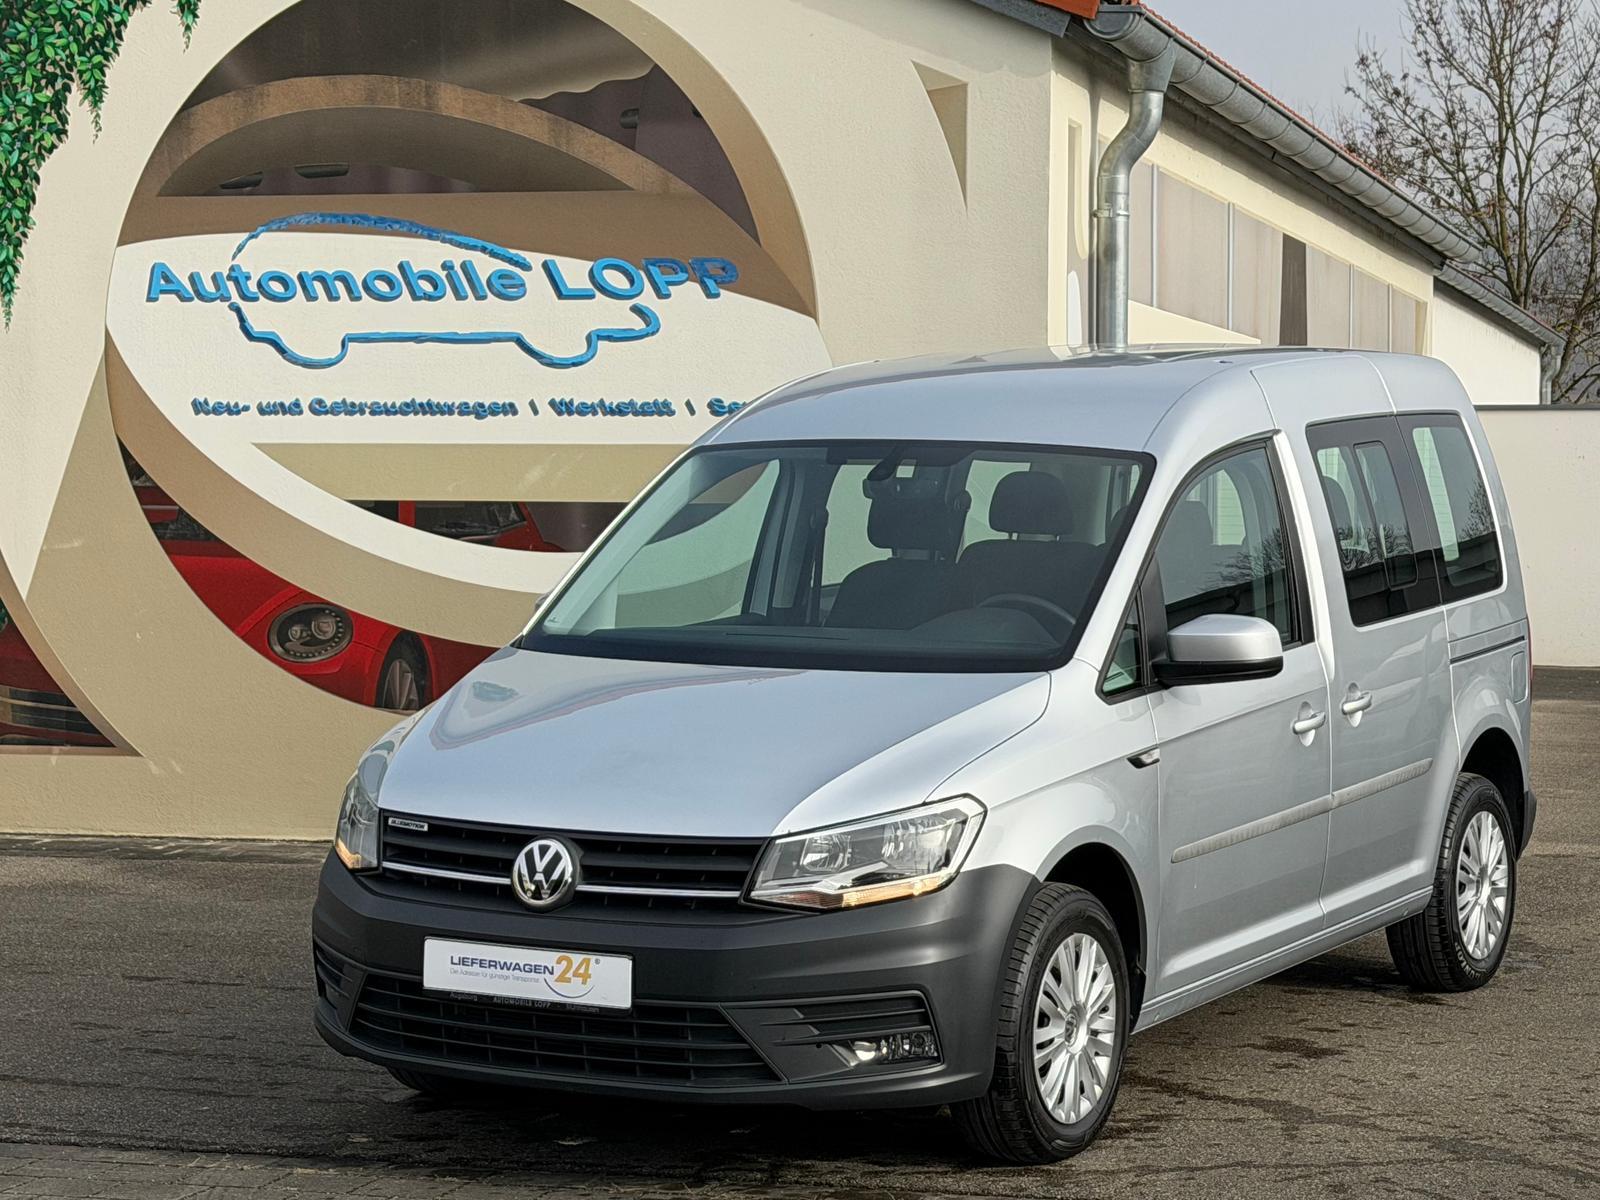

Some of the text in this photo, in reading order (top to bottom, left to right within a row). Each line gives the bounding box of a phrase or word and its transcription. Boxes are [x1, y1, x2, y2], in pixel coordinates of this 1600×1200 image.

[146, 257, 740, 302] Automobile LOPP
[191, 397, 250, 417] Neu-
[256, 398, 303, 417] und
[308, 397, 518, 419] Gebrauchtwagen
[548, 397, 676, 417] Werkstatt
[450, 955, 555, 976] LIEFERWAGEN
